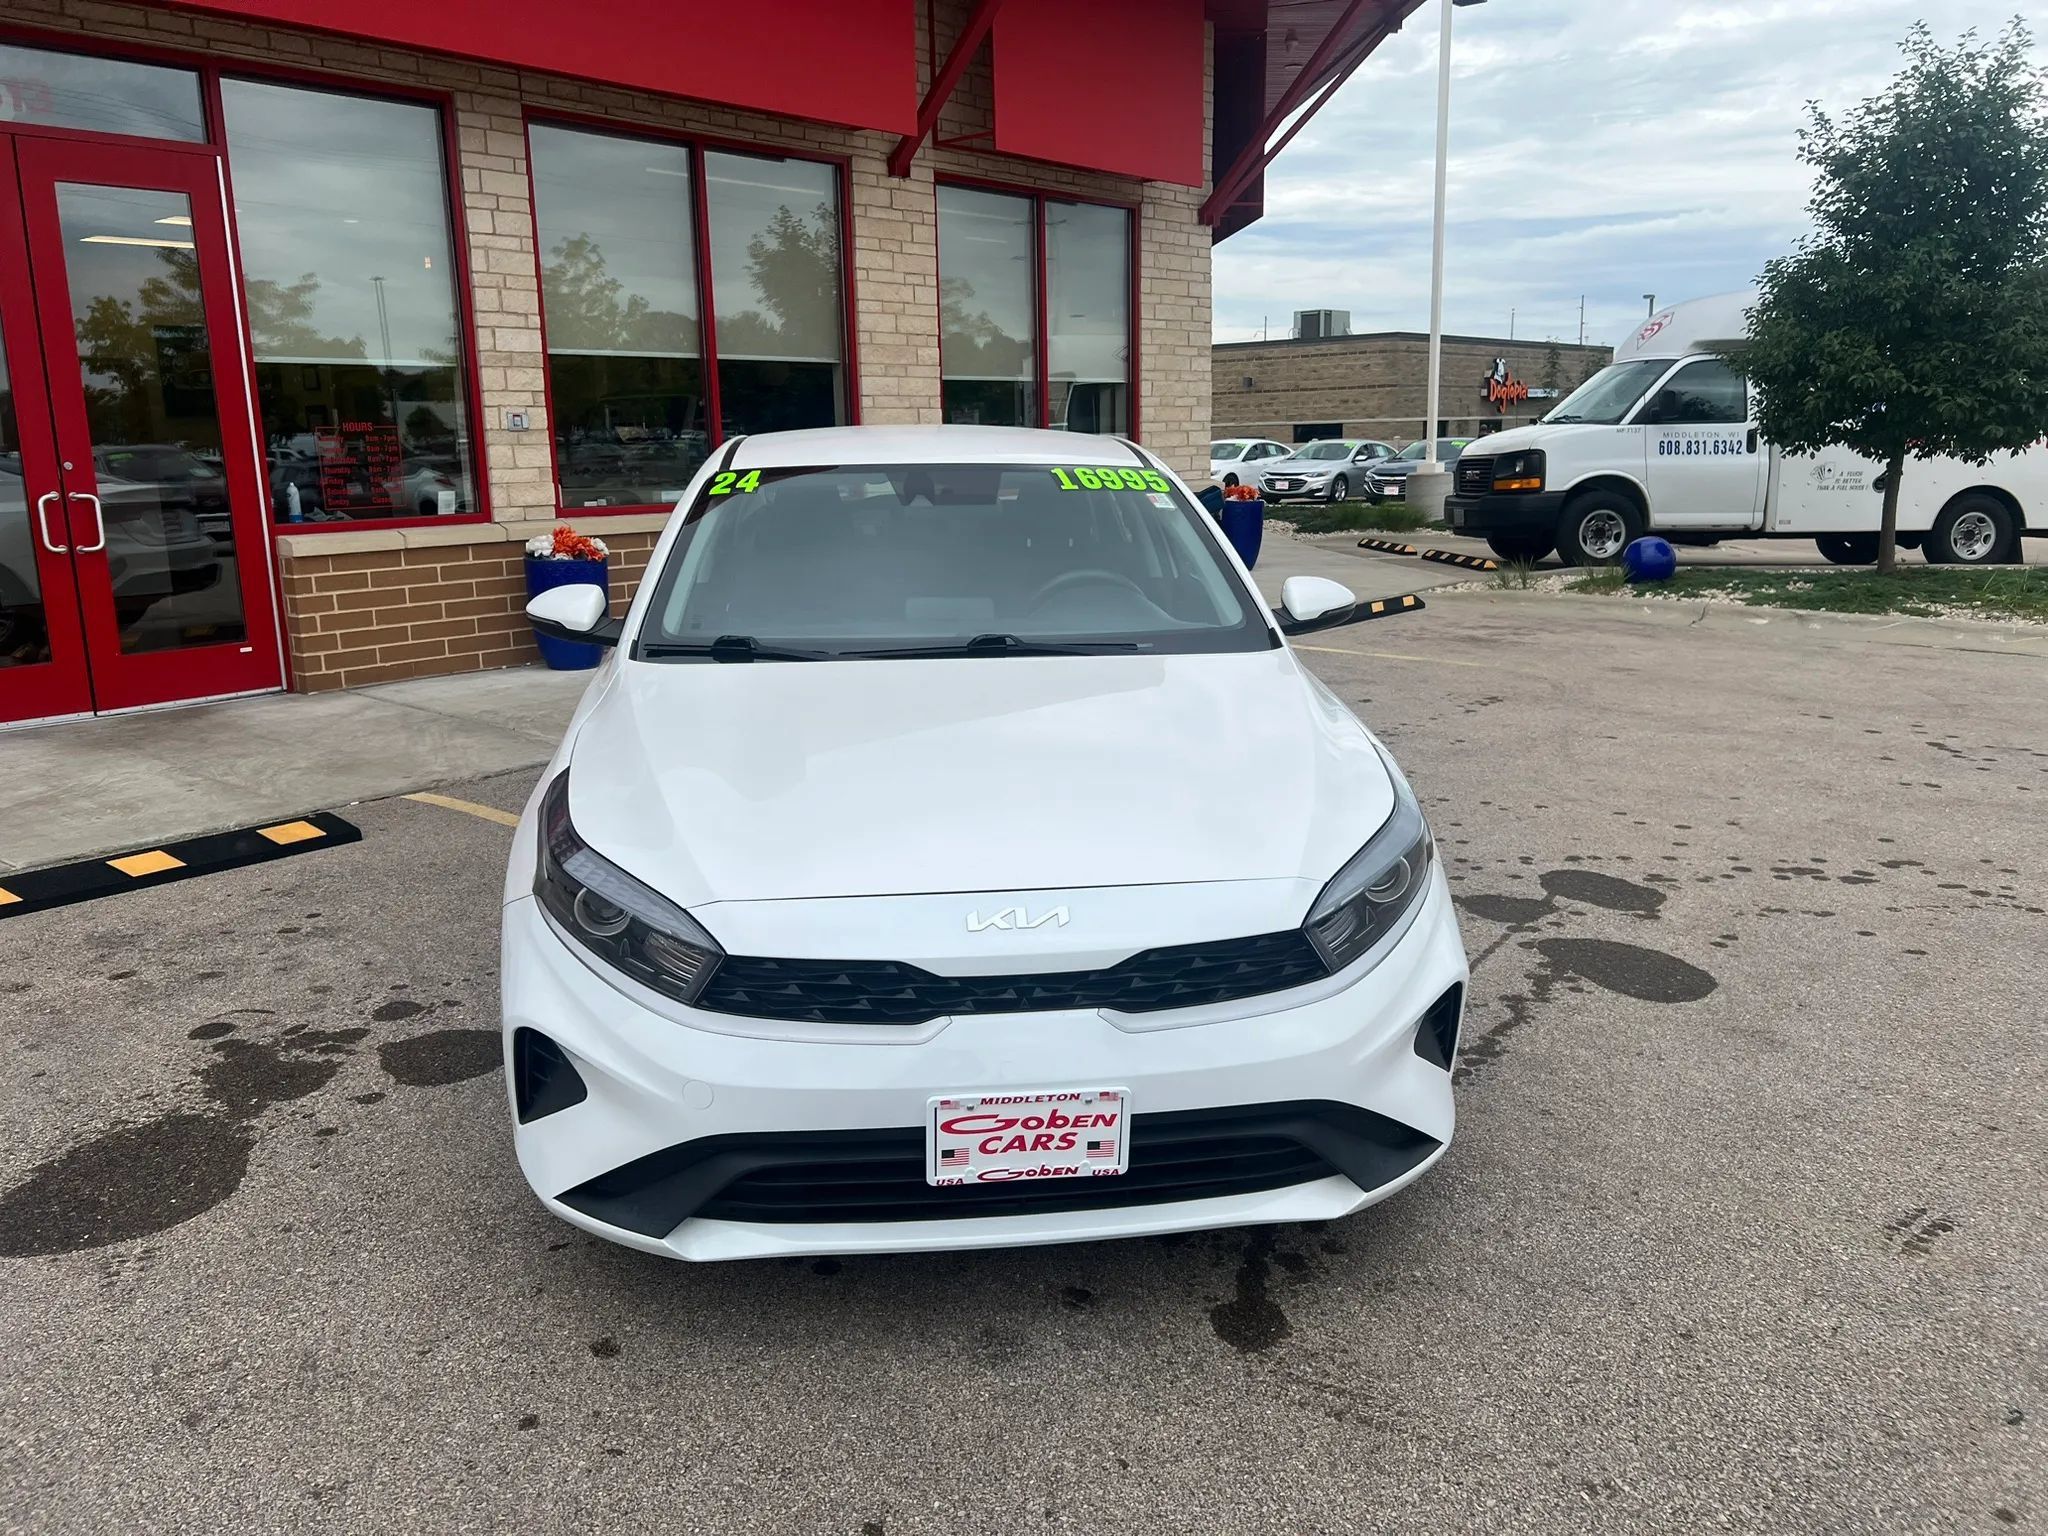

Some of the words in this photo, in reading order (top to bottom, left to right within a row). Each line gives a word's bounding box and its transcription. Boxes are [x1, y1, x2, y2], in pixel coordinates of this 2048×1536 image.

[1490, 368, 1528, 414] Dogtopia
[342, 422, 373, 431] HOURS
[1658, 440, 1743, 456] 608.831.6342
[708, 469, 761, 495] 24
[1050, 466, 1171, 493] 16995
[979, 1092, 1081, 1106] MIDDLETON
[978, 1131, 1079, 1155] CARS
[936, 1177, 965, 1187] USA
[1092, 1167, 1120, 1177] USA
